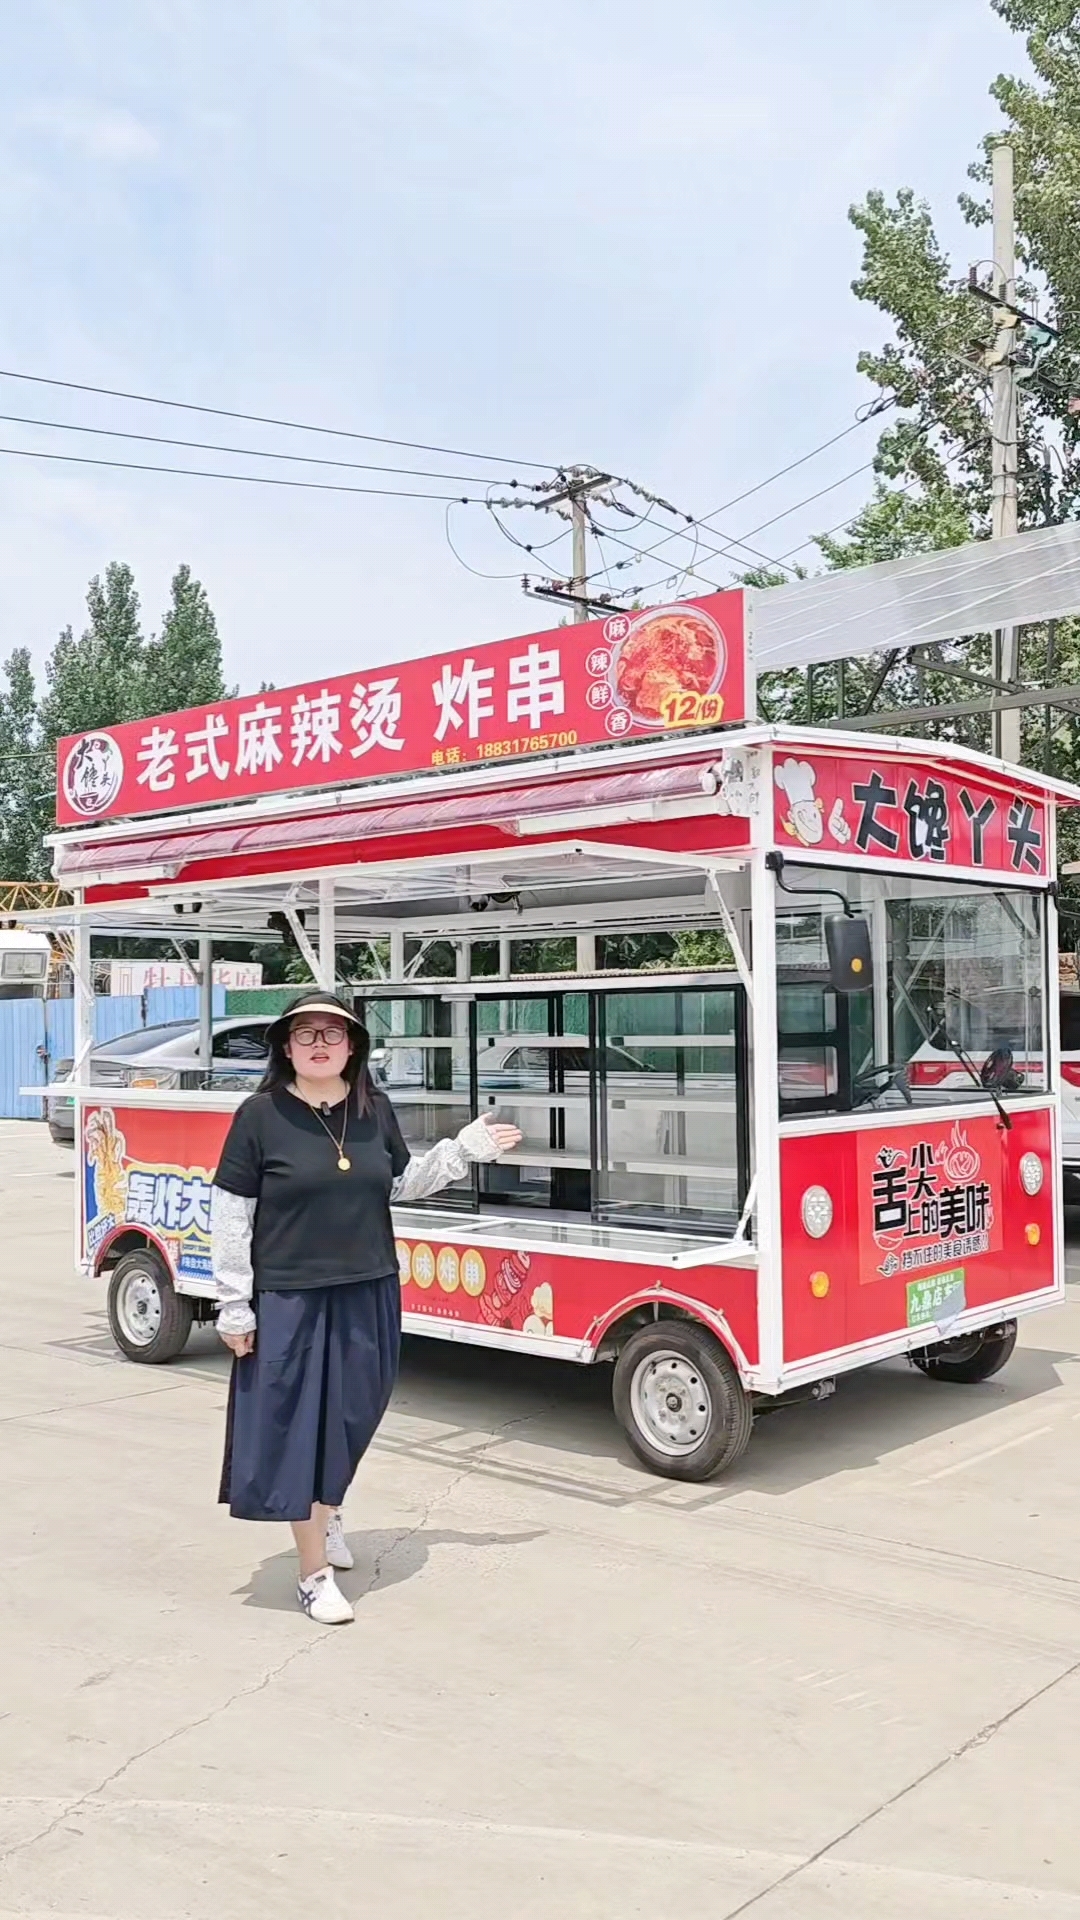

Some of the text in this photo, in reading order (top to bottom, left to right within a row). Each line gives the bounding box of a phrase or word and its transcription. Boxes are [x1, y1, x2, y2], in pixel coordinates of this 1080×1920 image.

[135, 643, 565, 793] 老式麻辣烫 炸串
[476, 729, 578, 759] 18831765700
[852, 769, 1042, 874] 大馋丫头
[126, 1170, 214, 1234] 轰炸大
